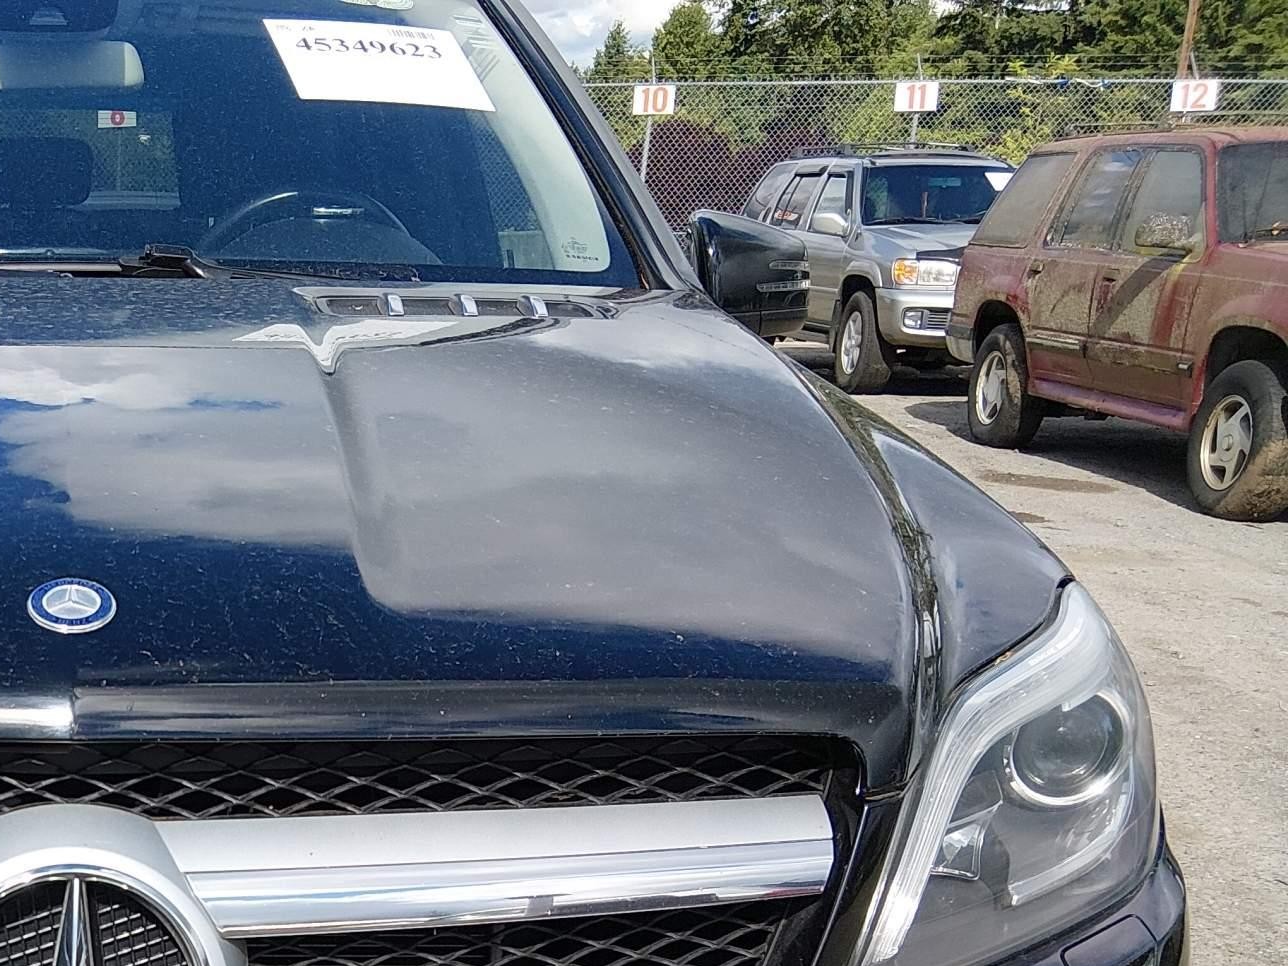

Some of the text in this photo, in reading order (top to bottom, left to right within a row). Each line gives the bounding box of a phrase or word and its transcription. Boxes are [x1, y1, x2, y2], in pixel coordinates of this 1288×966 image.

[295, 36, 443, 60] 45349623
[641, 86, 668, 113] 10
[906, 83, 927, 110] 11
[1181, 83, 1209, 109] 12
